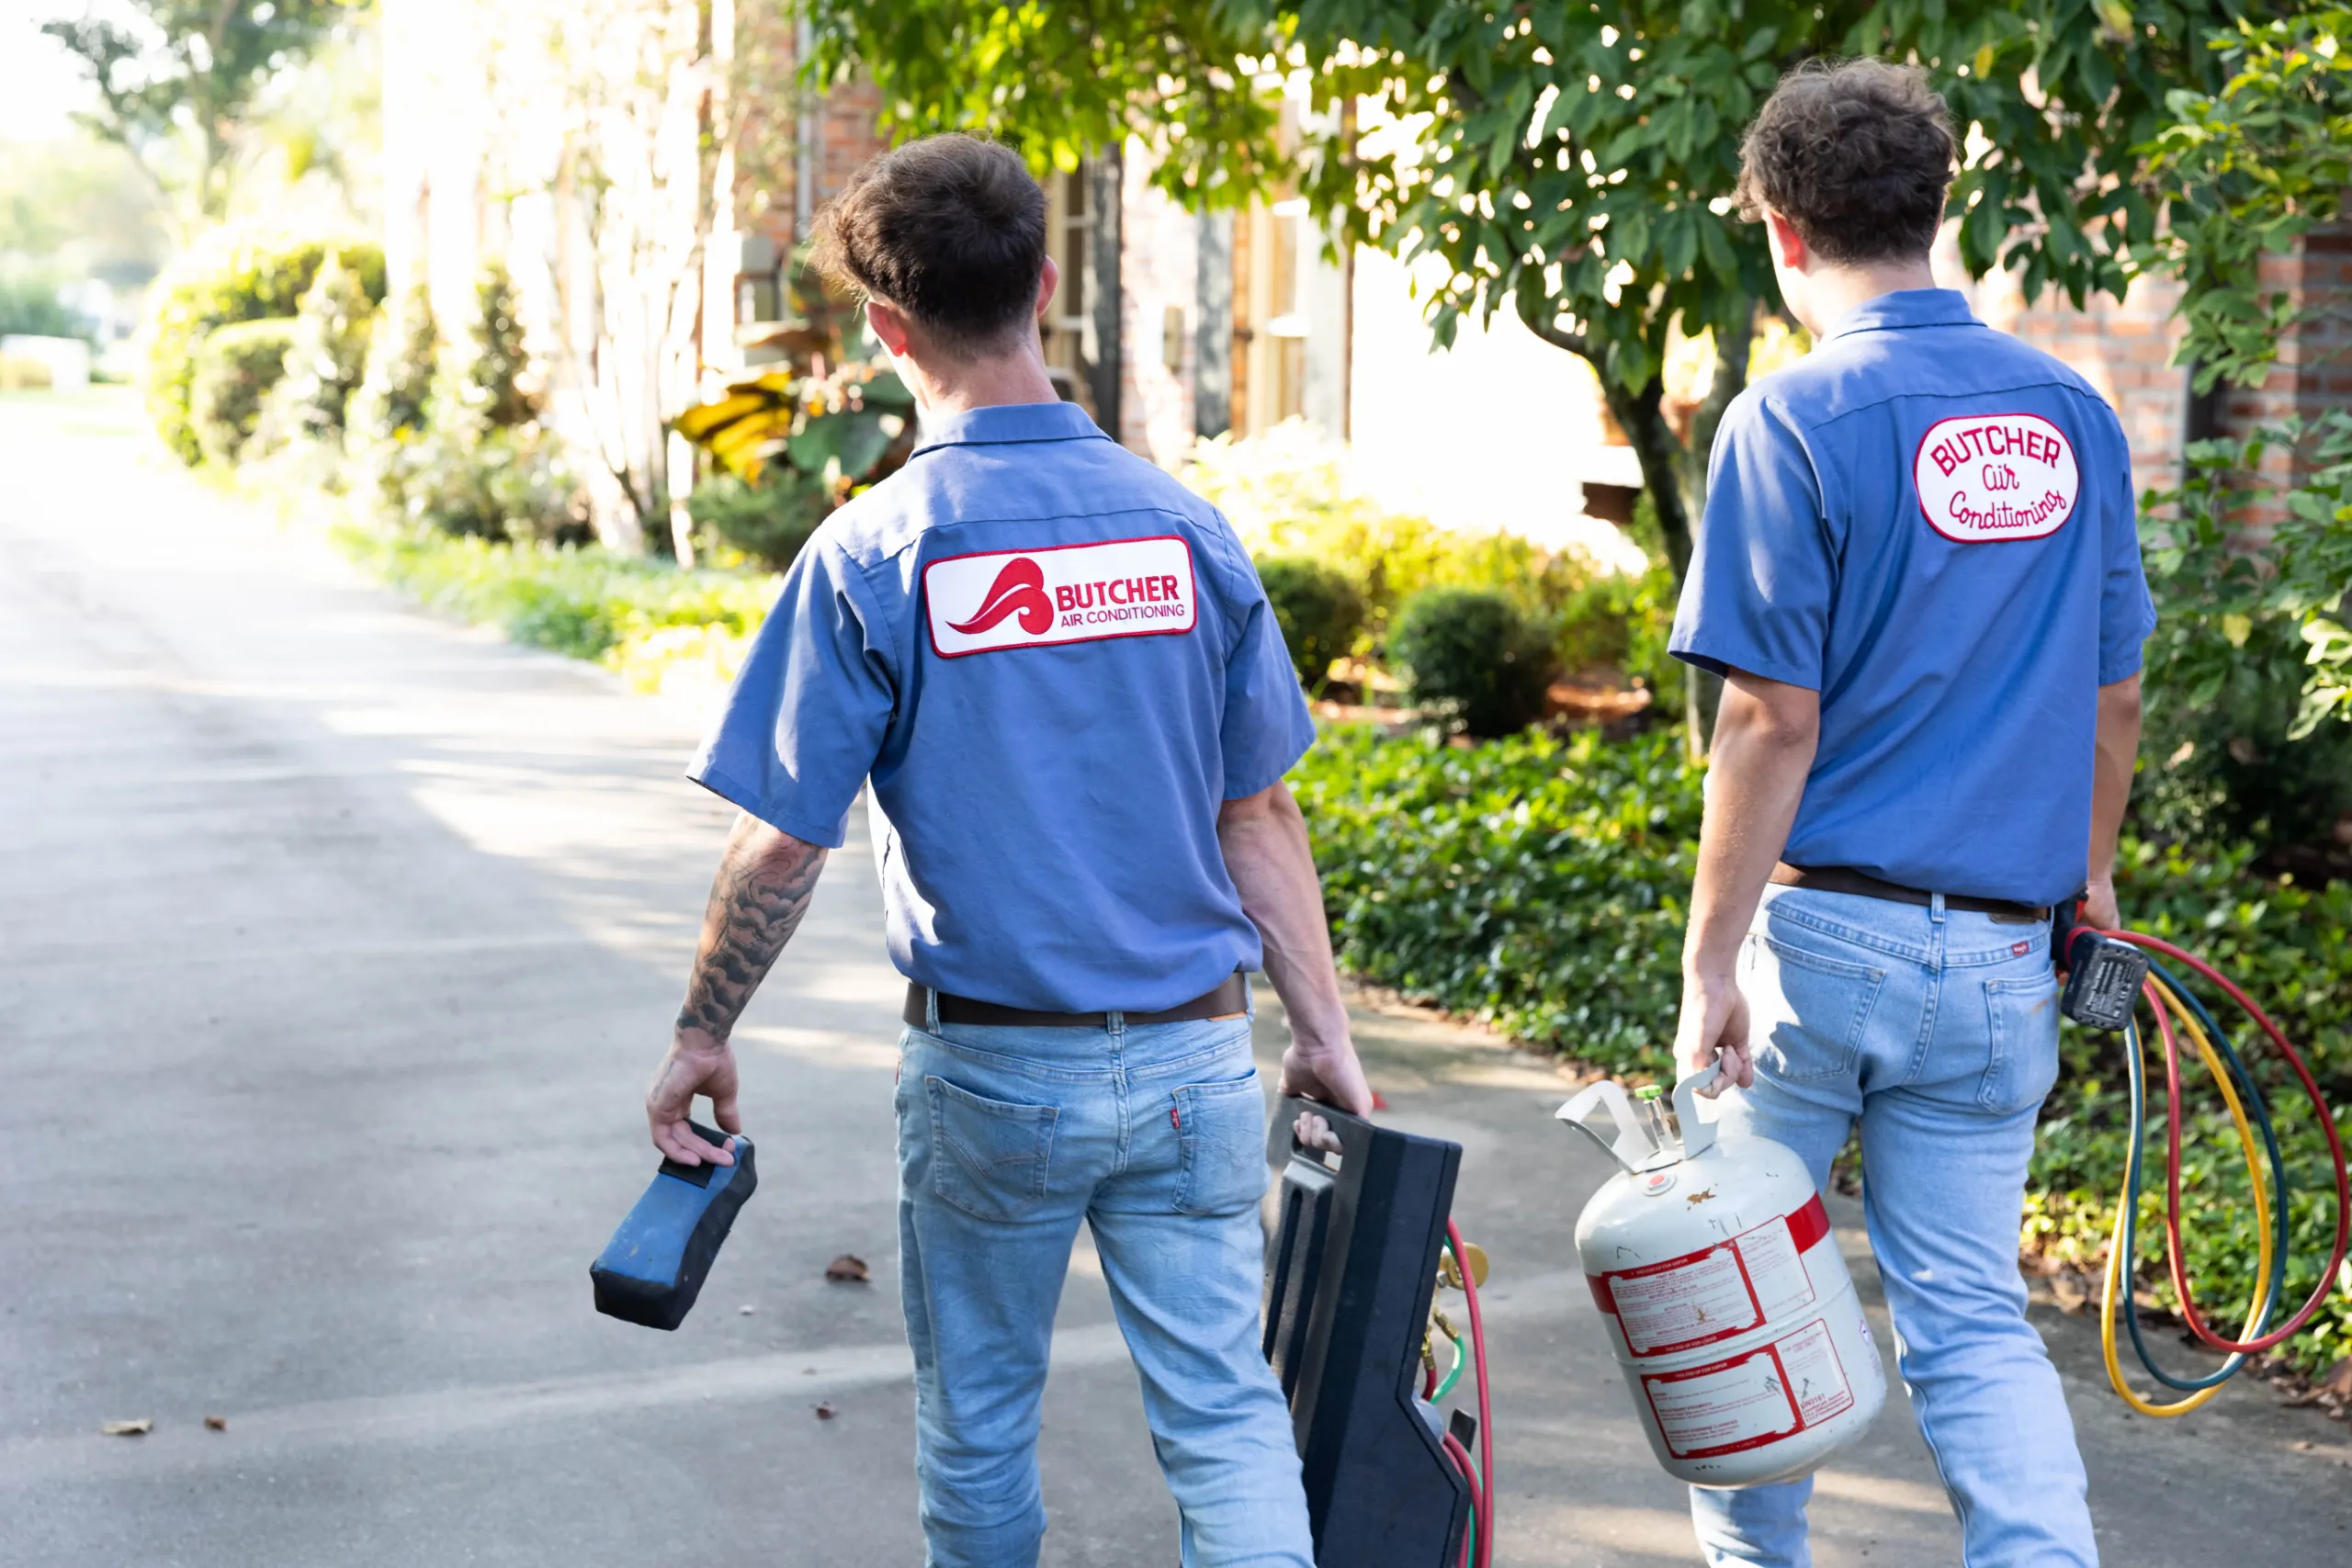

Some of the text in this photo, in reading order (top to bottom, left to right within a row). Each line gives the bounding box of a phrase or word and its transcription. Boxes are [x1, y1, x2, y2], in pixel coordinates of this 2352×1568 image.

[1930, 425, 2061, 477] BUTCHER
[1982, 464, 2020, 491] Air
[1949, 489, 2066, 530] Conditioning
[1056, 575, 1180, 611] BUTCHER
[1061, 604, 1185, 627] AIR CONDITIONING
